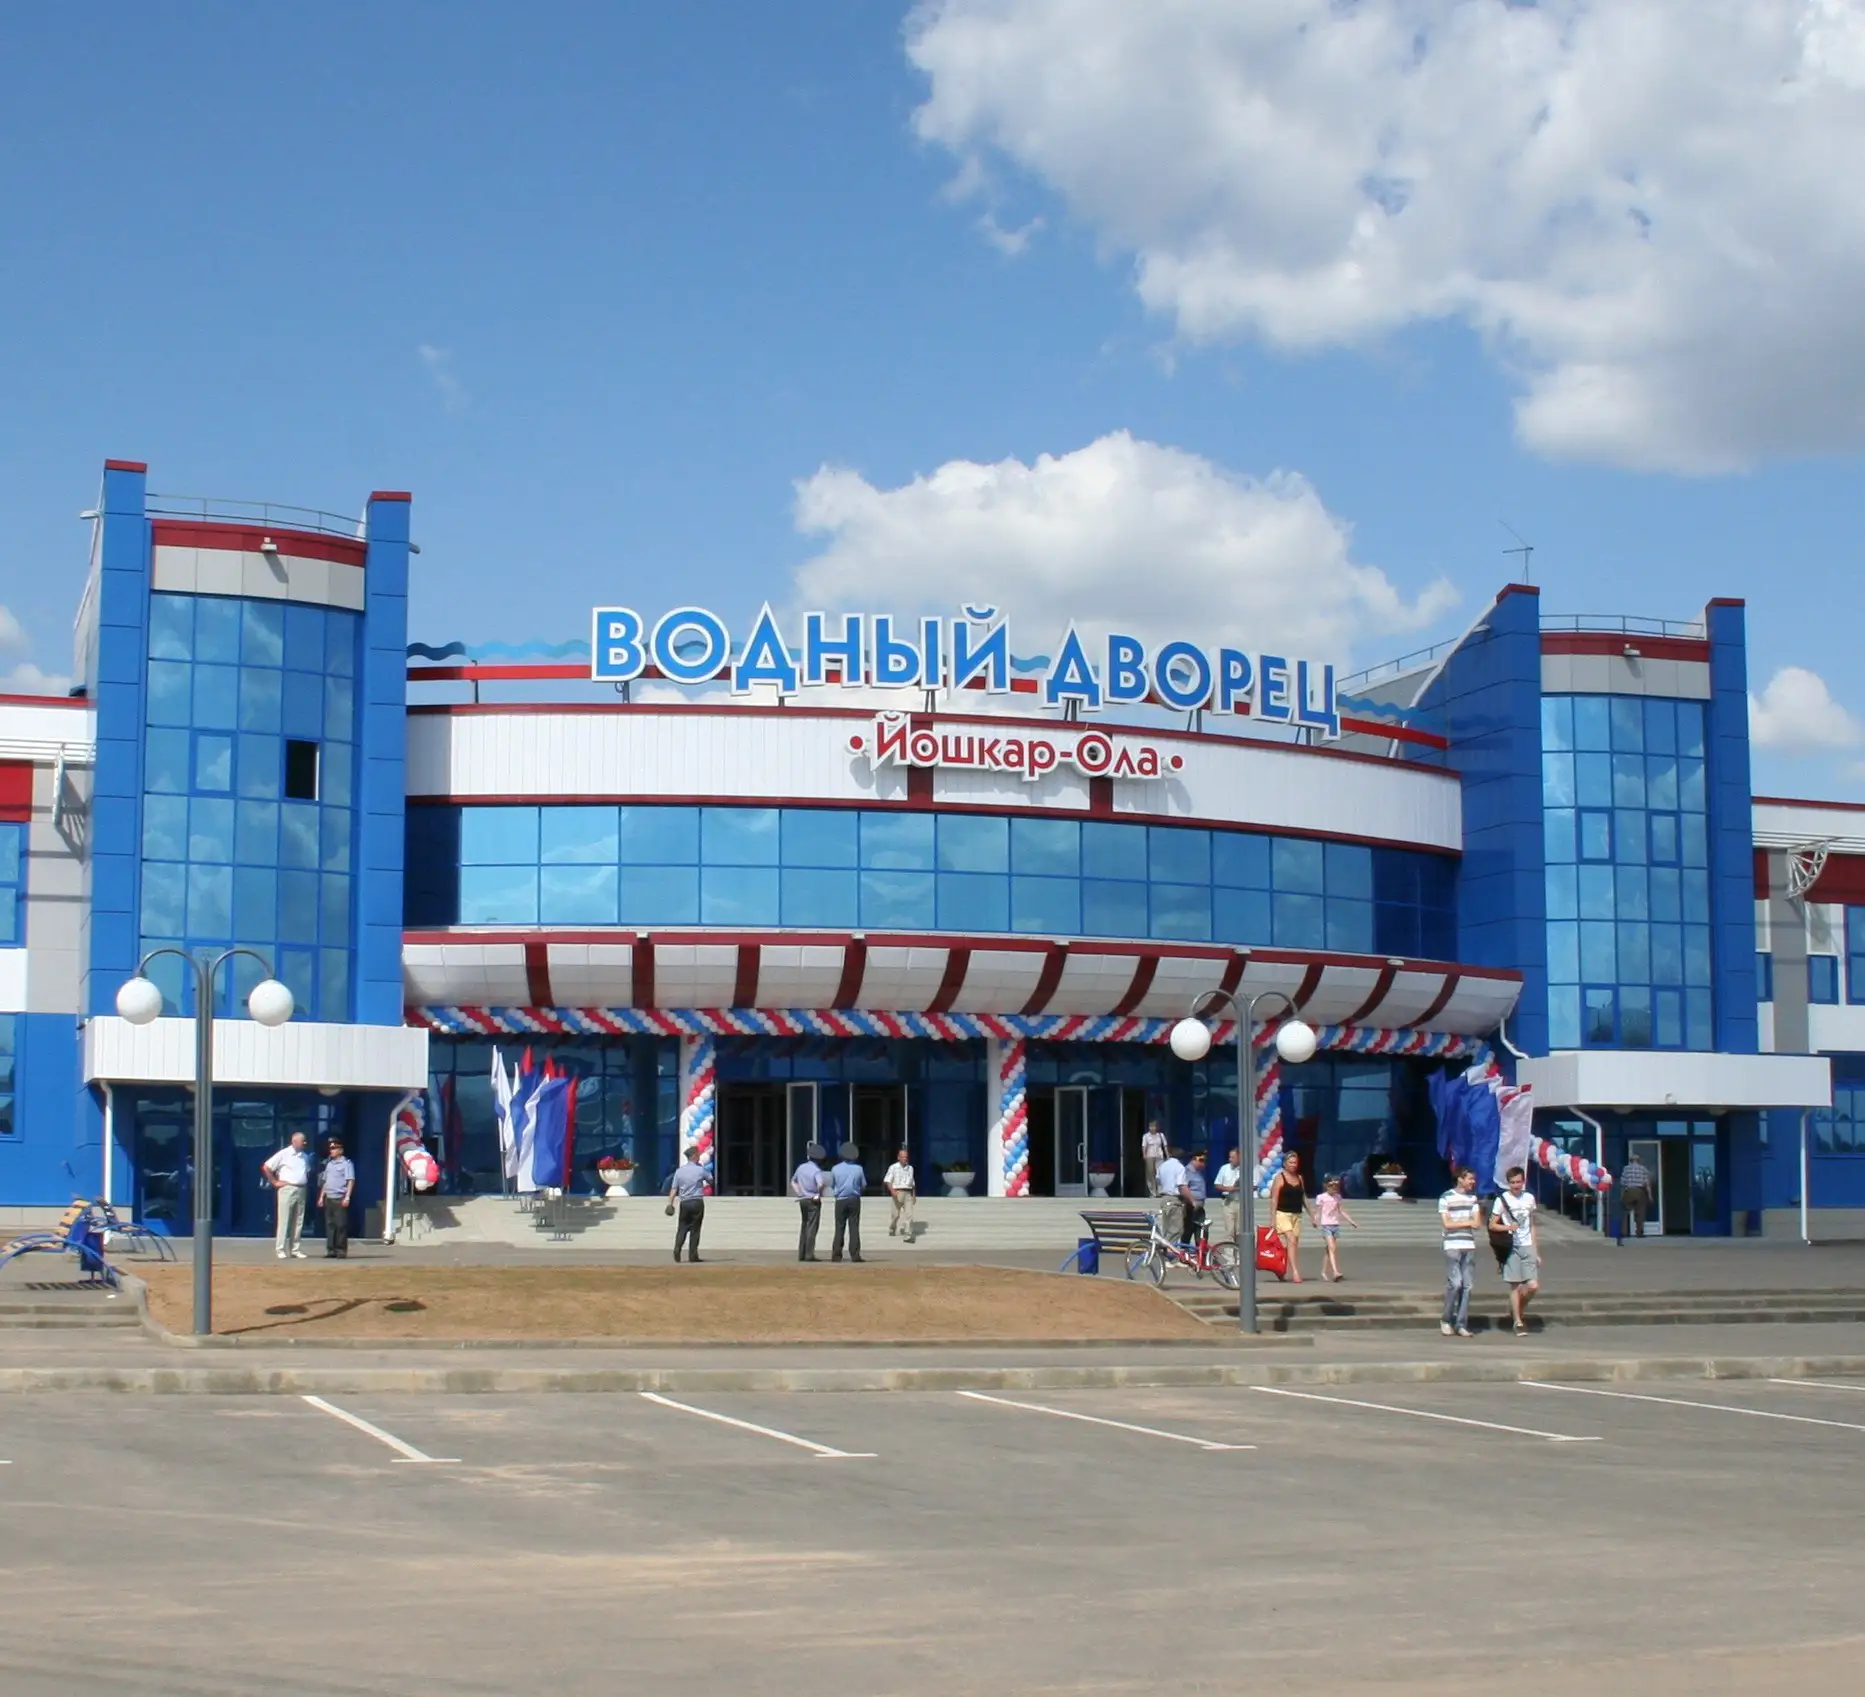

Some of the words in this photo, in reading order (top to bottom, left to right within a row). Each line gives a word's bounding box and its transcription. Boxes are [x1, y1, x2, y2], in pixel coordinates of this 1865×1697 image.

[591, 602, 1009, 699] ВОДНЫЙ
[1042, 619, 1341, 738] ДВОРЕЦ
[872, 711, 1161, 780] Йошкар-Ола
